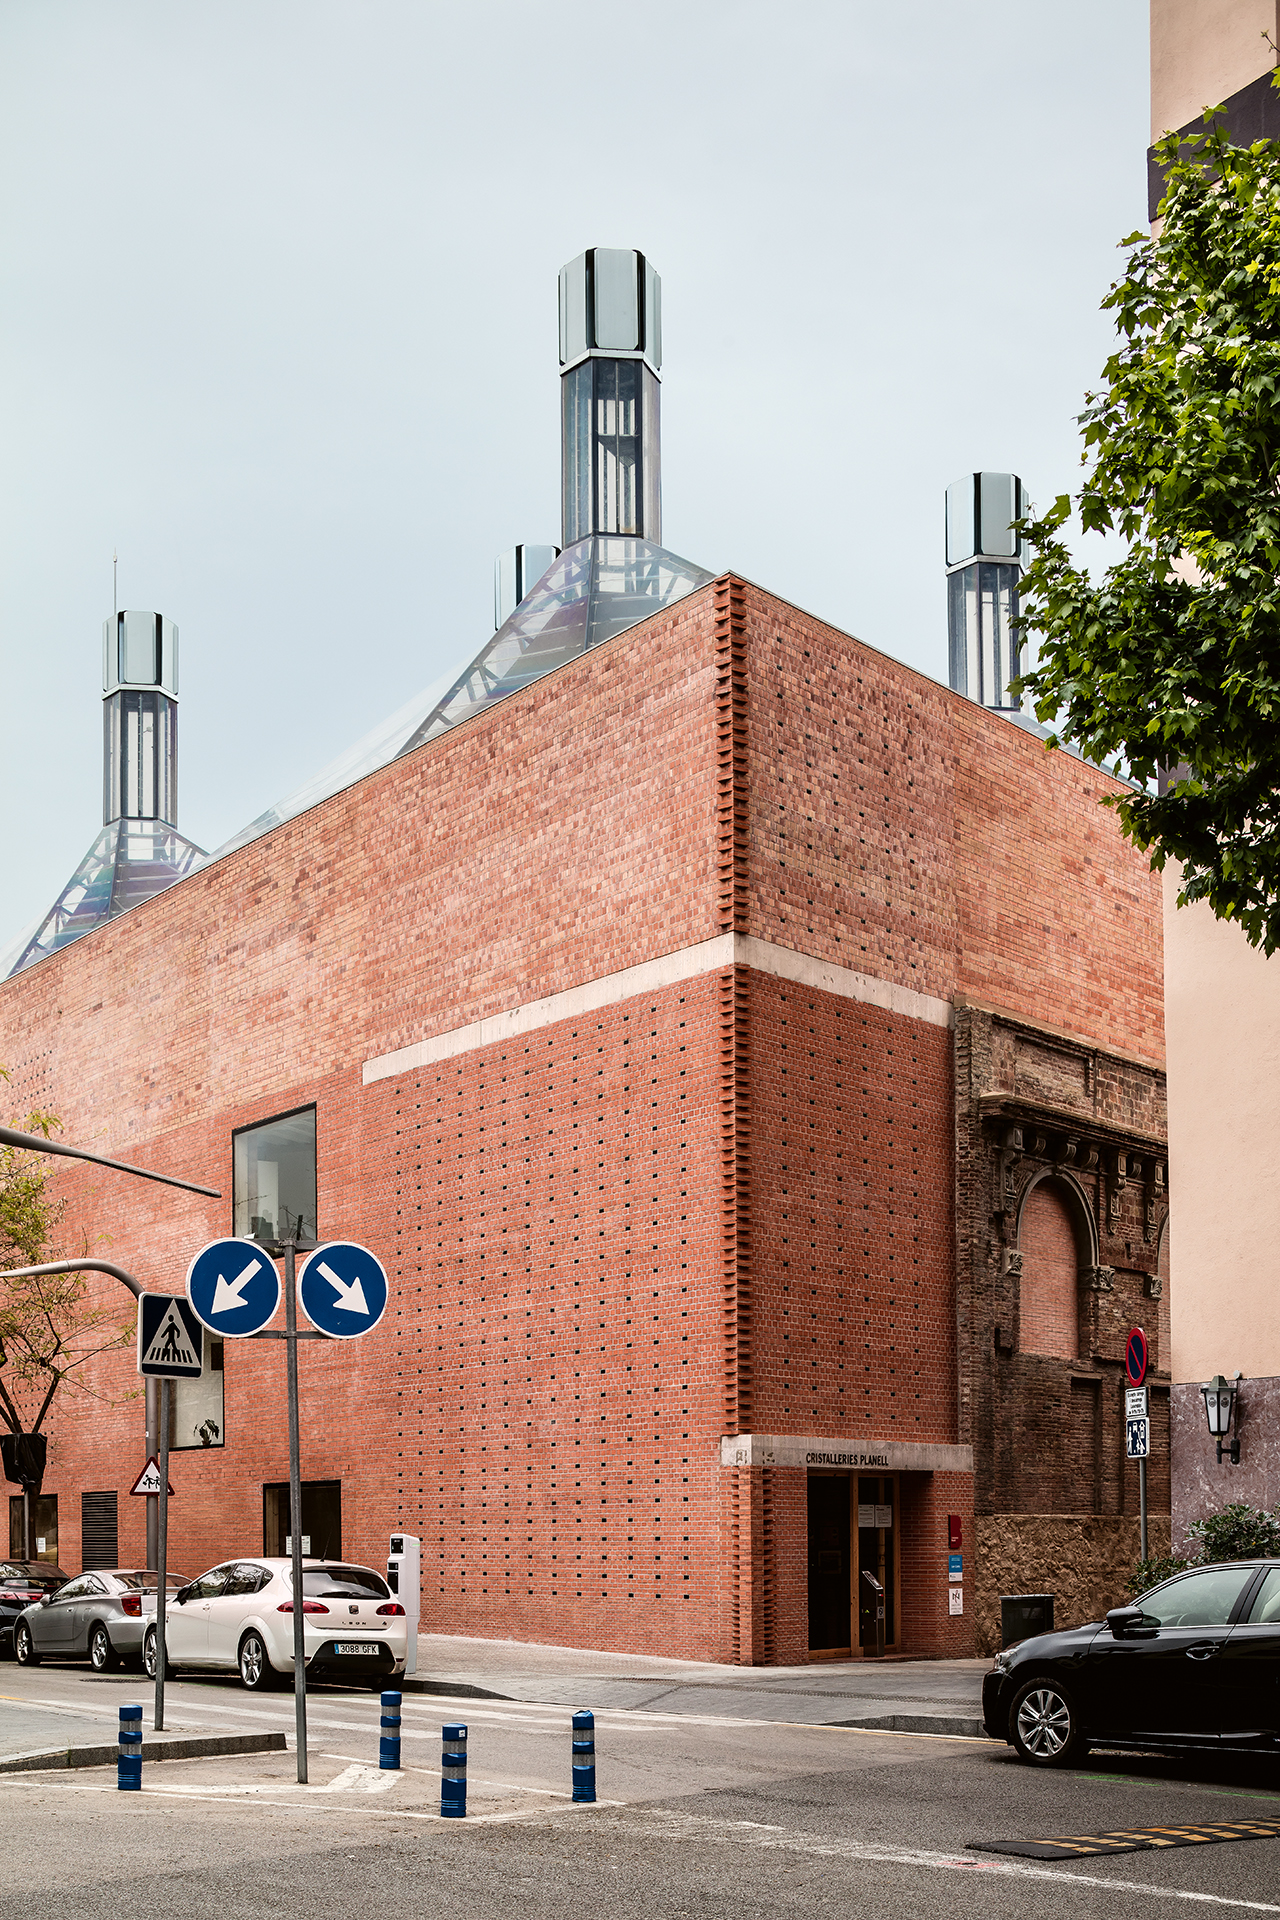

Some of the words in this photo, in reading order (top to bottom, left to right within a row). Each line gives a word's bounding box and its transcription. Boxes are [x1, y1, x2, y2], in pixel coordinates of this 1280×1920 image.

[805, 1452, 858, 1465] CRISTALLERIES
[860, 1454, 889, 1466] PLANELL
[340, 1645, 360, 1653] 3088
[362, 1645, 377, 1654] GFK
